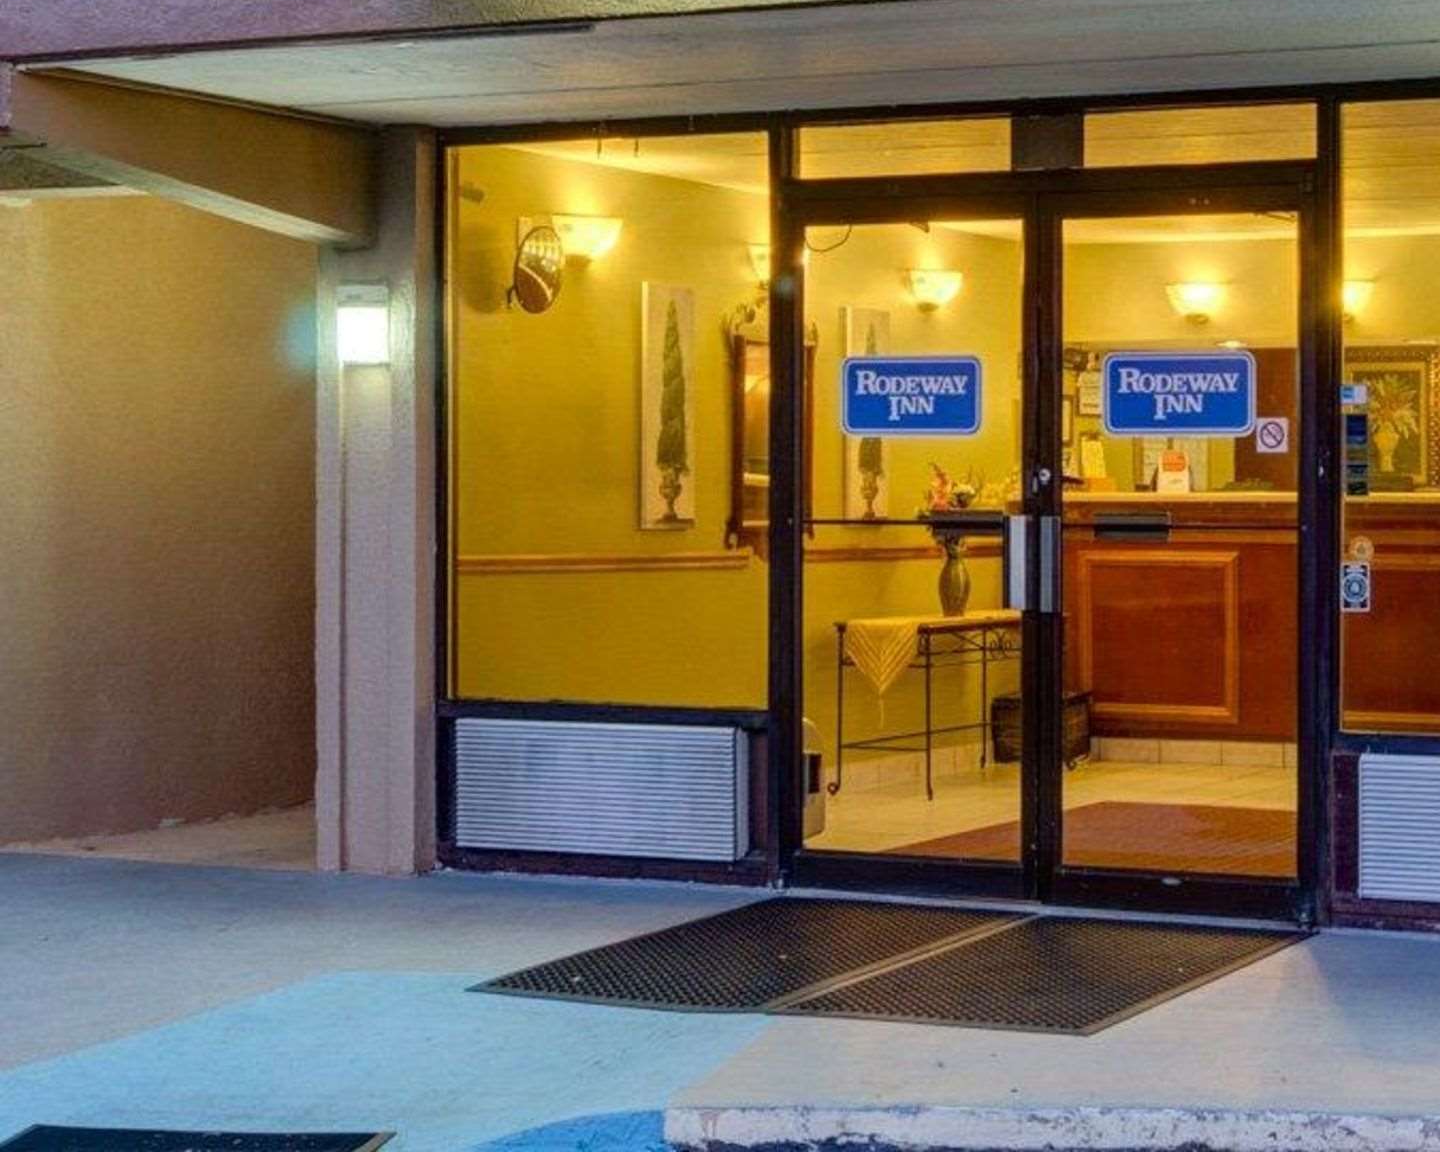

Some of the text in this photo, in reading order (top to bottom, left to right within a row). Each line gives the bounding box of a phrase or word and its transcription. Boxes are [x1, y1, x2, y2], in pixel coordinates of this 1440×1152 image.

[855, 369, 969, 396] RODEWAY
[1118, 366, 1240, 395] RODEWAY
[888, 395, 935, 421] INN
[1153, 393, 1204, 421] INN
